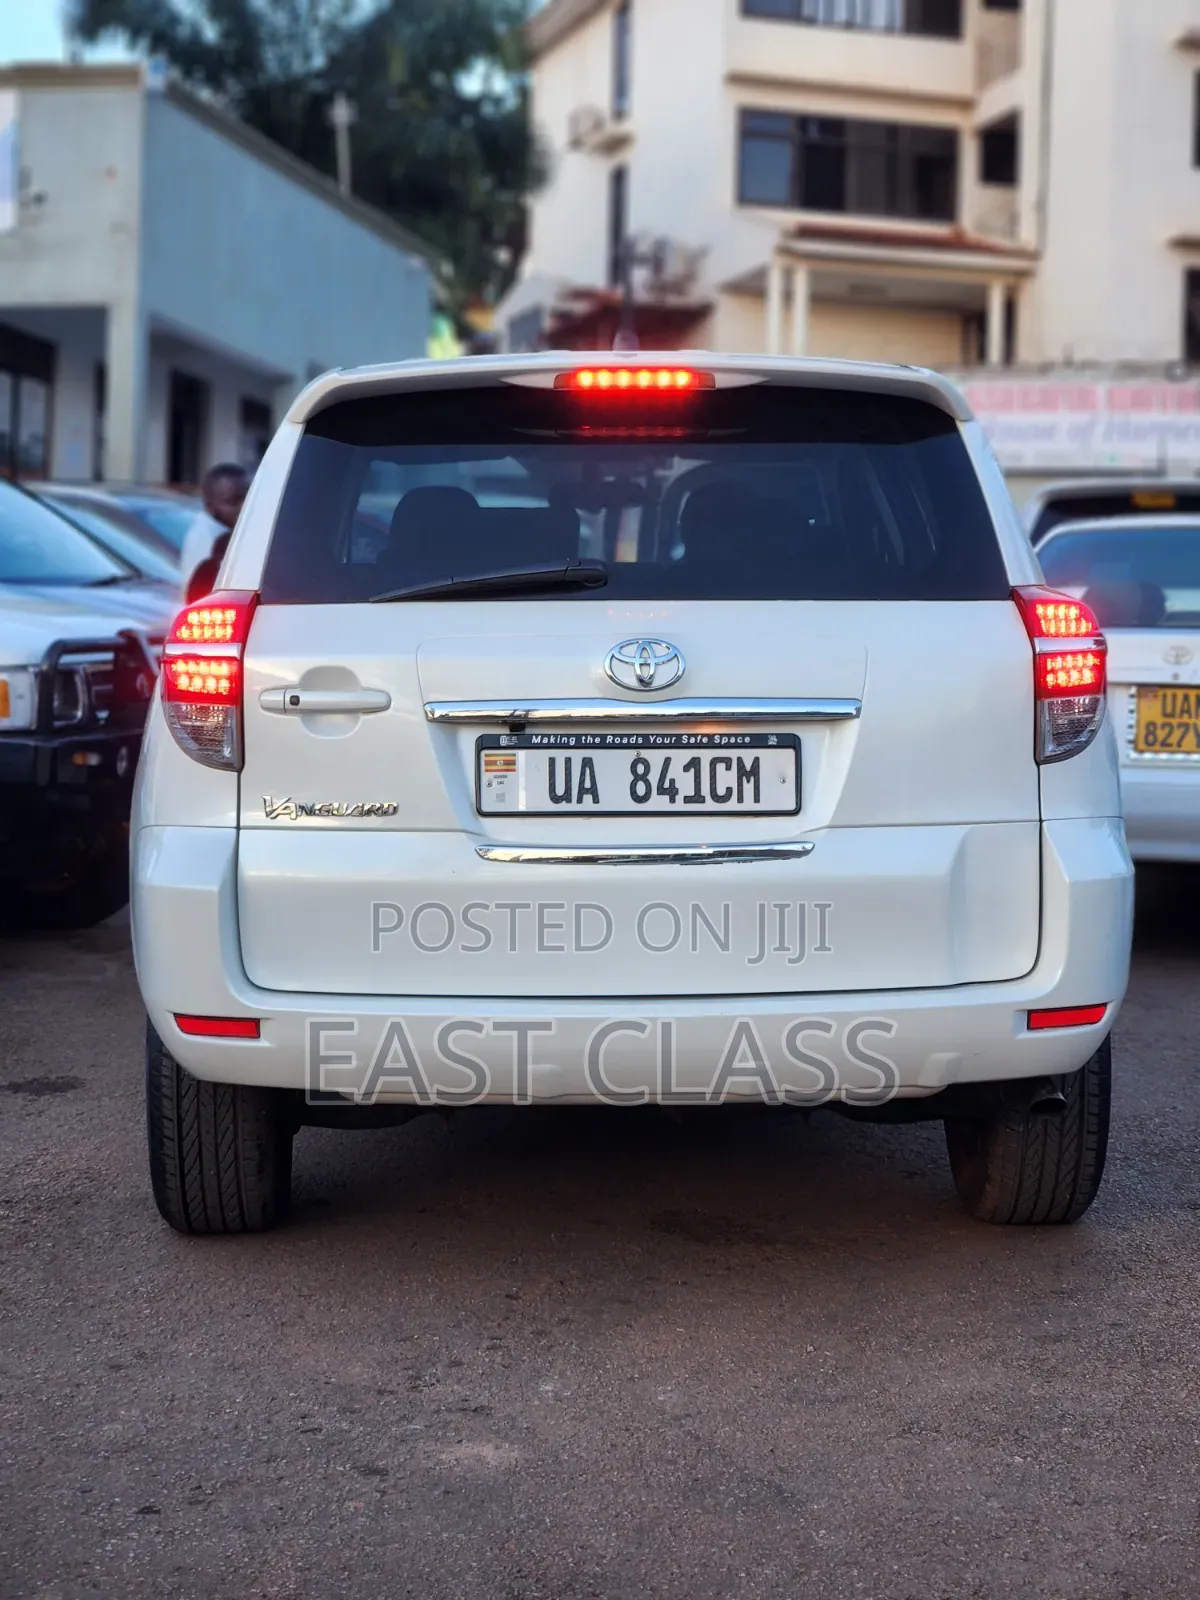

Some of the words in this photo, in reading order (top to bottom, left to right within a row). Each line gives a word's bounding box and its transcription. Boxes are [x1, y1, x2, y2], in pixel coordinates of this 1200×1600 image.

[531, 735, 576, 746] Making
[581, 735, 601, 744] the
[606, 735, 643, 744] Roads
[649, 735, 677, 744] Your
[681, 735, 709, 744] Safe
[713, 735, 751, 745] Space
[548, 756, 600, 804] UA
[629, 756, 760, 804] 841CM
[262, 795, 399, 820] VANGUARD
